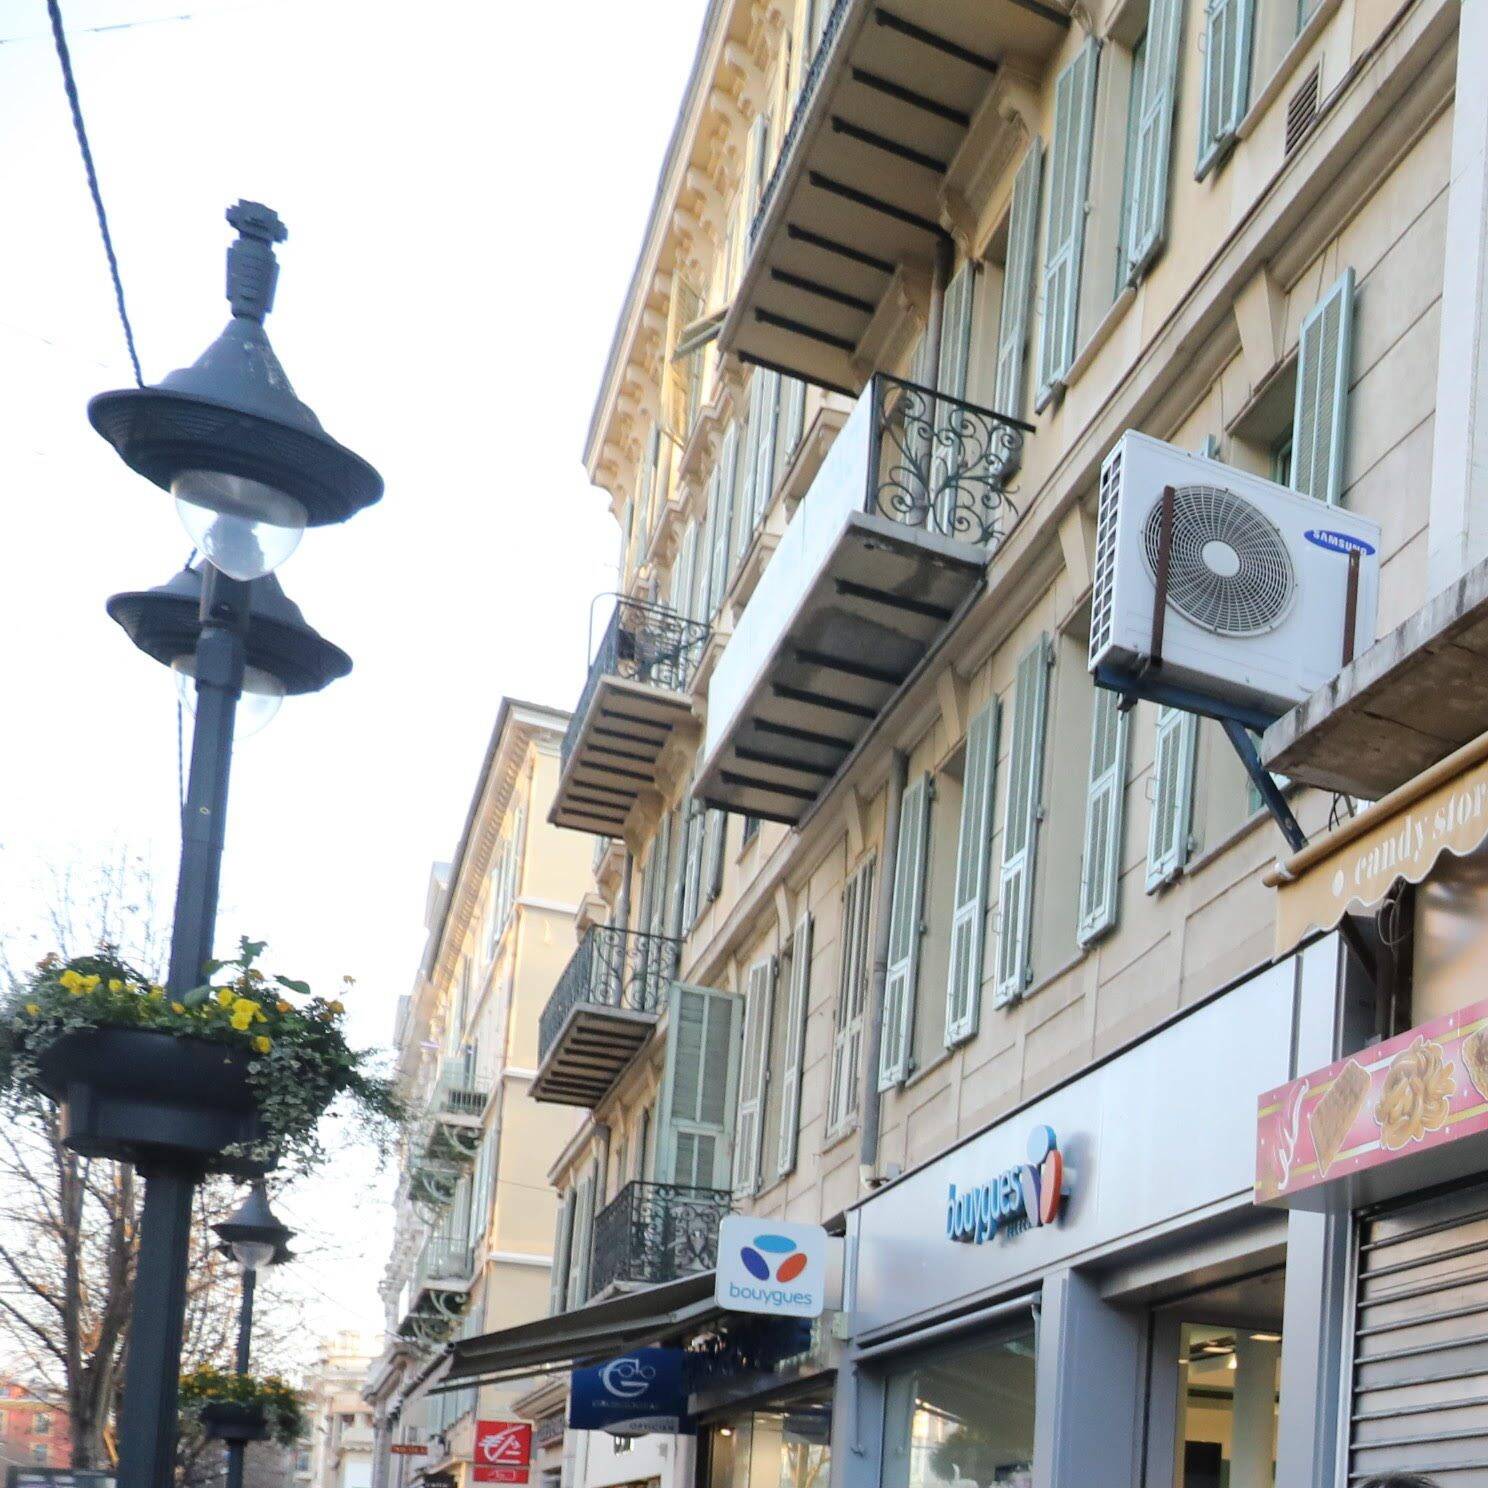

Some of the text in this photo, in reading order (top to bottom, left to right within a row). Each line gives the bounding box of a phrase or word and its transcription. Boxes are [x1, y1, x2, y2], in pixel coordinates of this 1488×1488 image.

[1354, 815, 1428, 886] candy
[947, 1166, 1023, 1244] bouygues
[729, 1282, 812, 1306] bouygues
